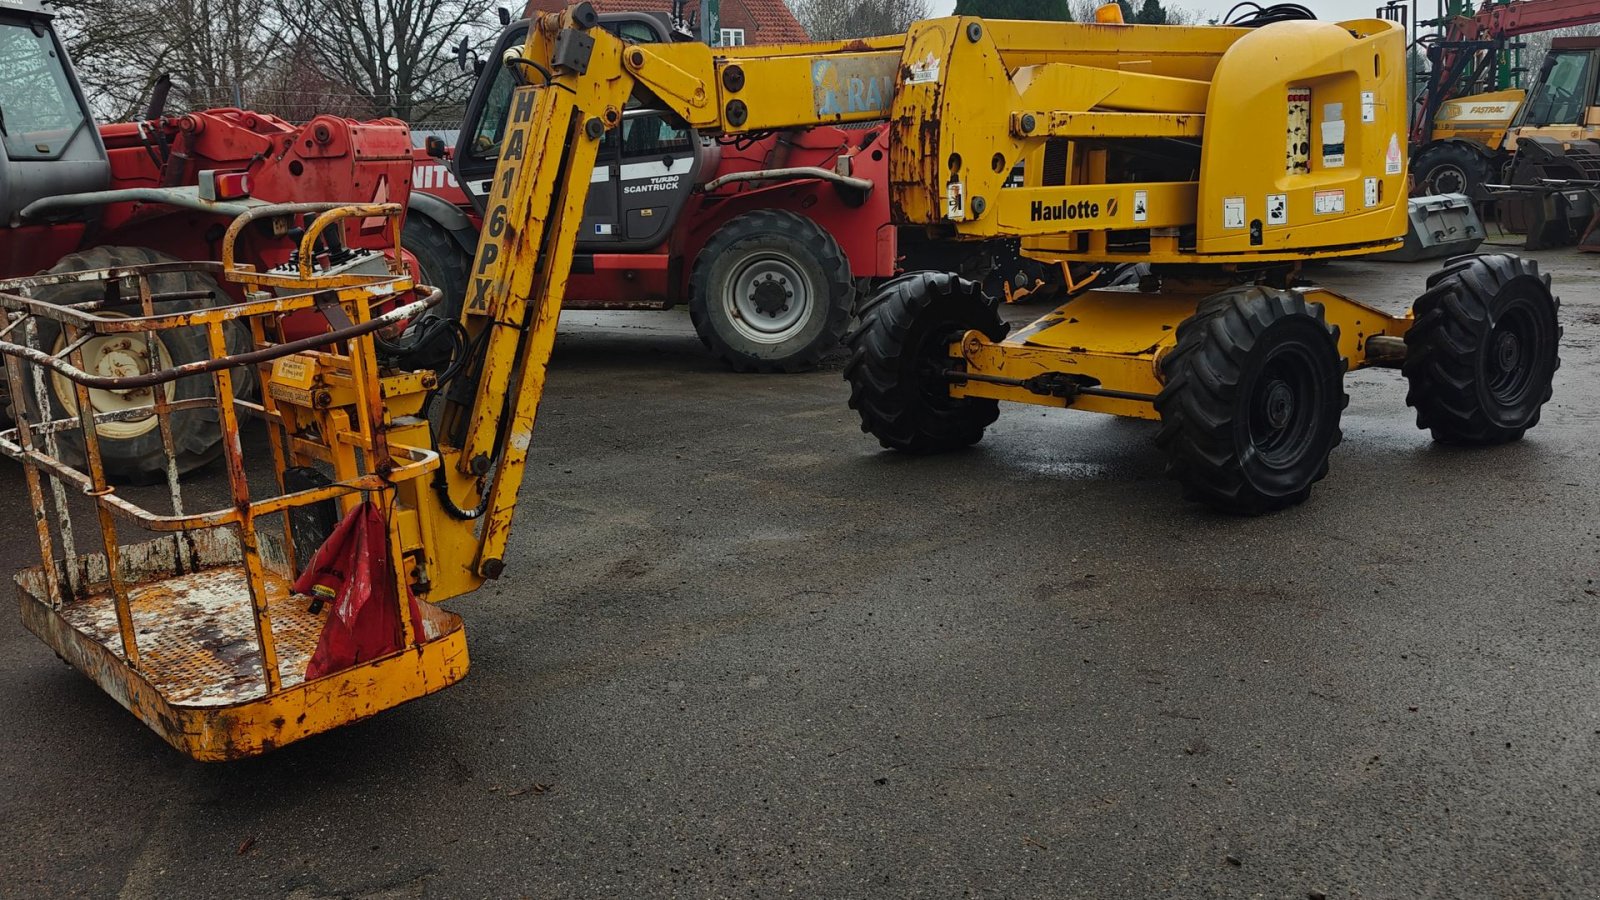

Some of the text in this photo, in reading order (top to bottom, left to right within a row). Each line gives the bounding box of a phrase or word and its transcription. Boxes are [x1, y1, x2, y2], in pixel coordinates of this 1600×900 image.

[1470, 106, 1505, 114] FASTRAC
[650, 175, 680, 184] TURBO
[623, 182, 679, 194] SCANTRUCK
[1031, 199, 1100, 222] Haulotte
